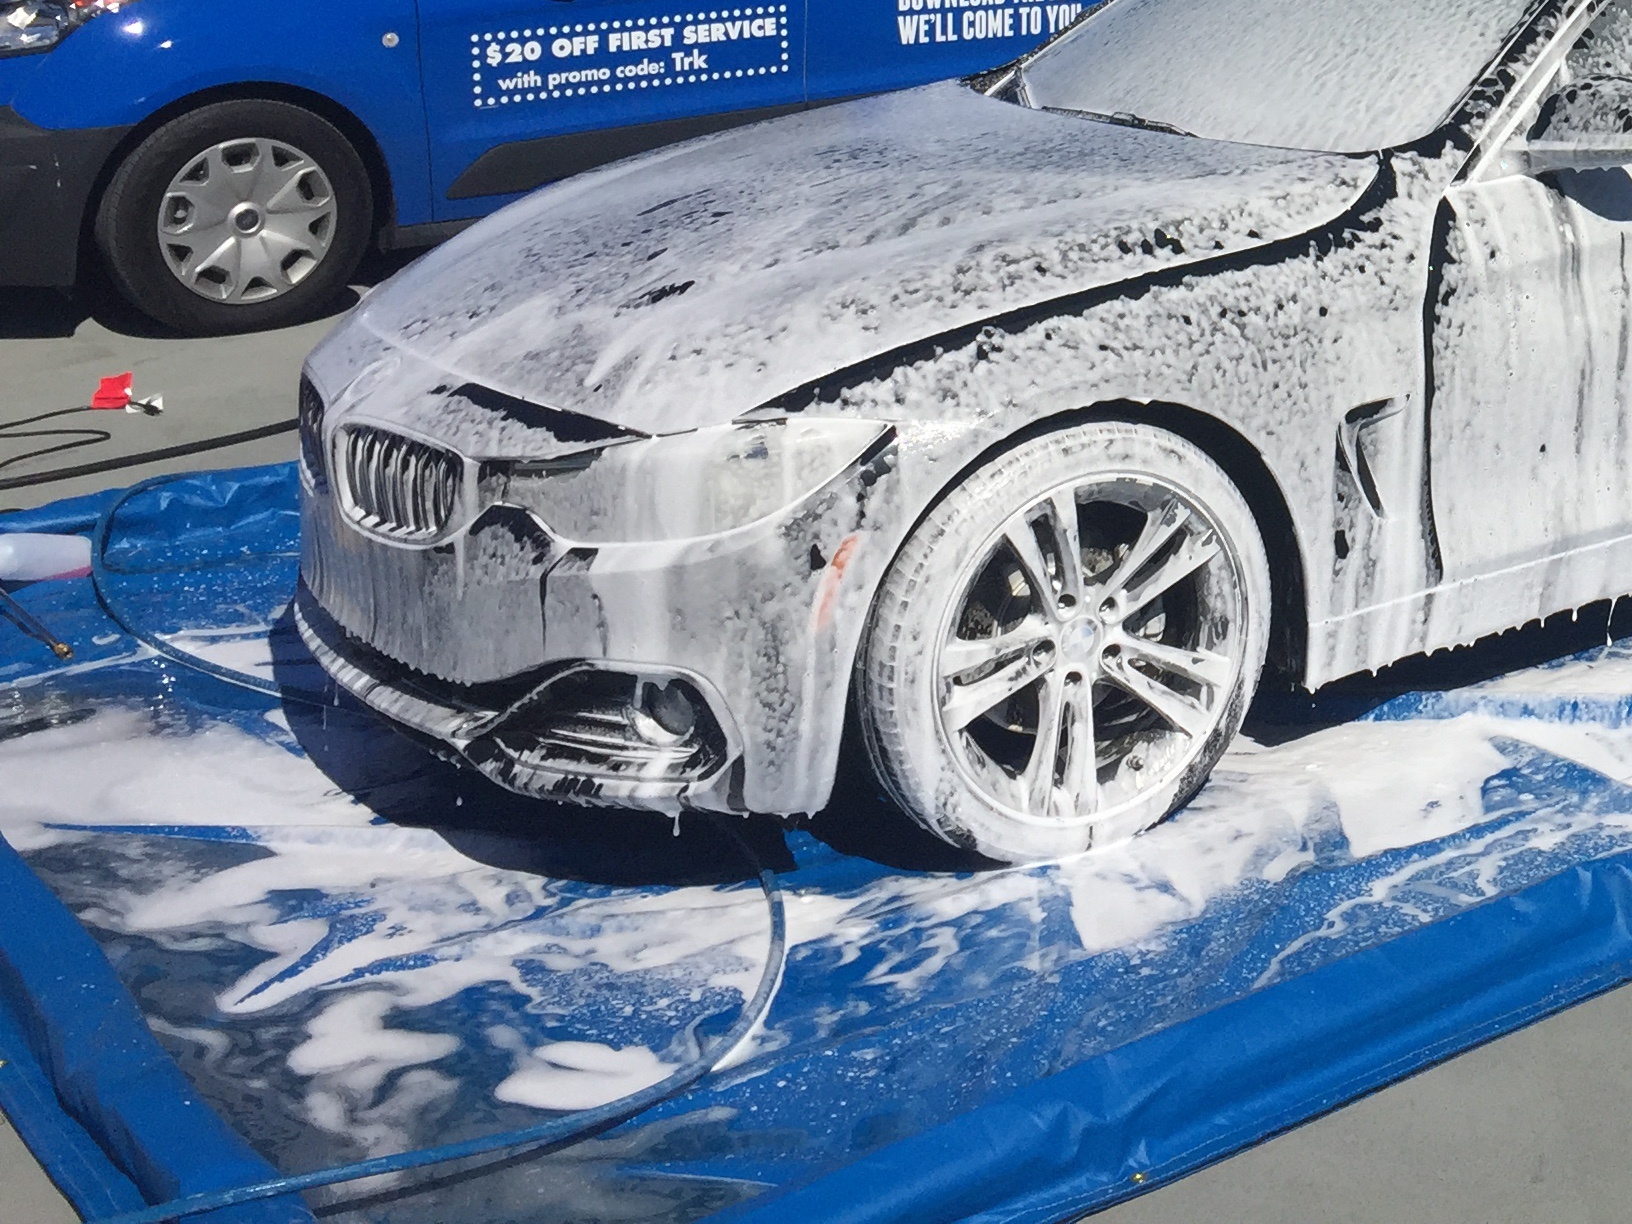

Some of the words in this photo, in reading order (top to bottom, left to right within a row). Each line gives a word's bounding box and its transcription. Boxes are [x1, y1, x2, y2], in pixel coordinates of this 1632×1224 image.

[486, 40, 542, 67] $20
[551, 35, 599, 58] OFF
[608, 28, 674, 52] FIRST
[683, 18, 777, 45] SERVICE
[897, 12, 958, 45] WE'LL
[962, 8, 1014, 40] COME
[1018, 6, 1042, 35] TO
[498, 70, 541, 91] with
[548, 67, 610, 90] promo
[616, 59, 665, 78] code:
[672, 49, 708, 72] Trk
